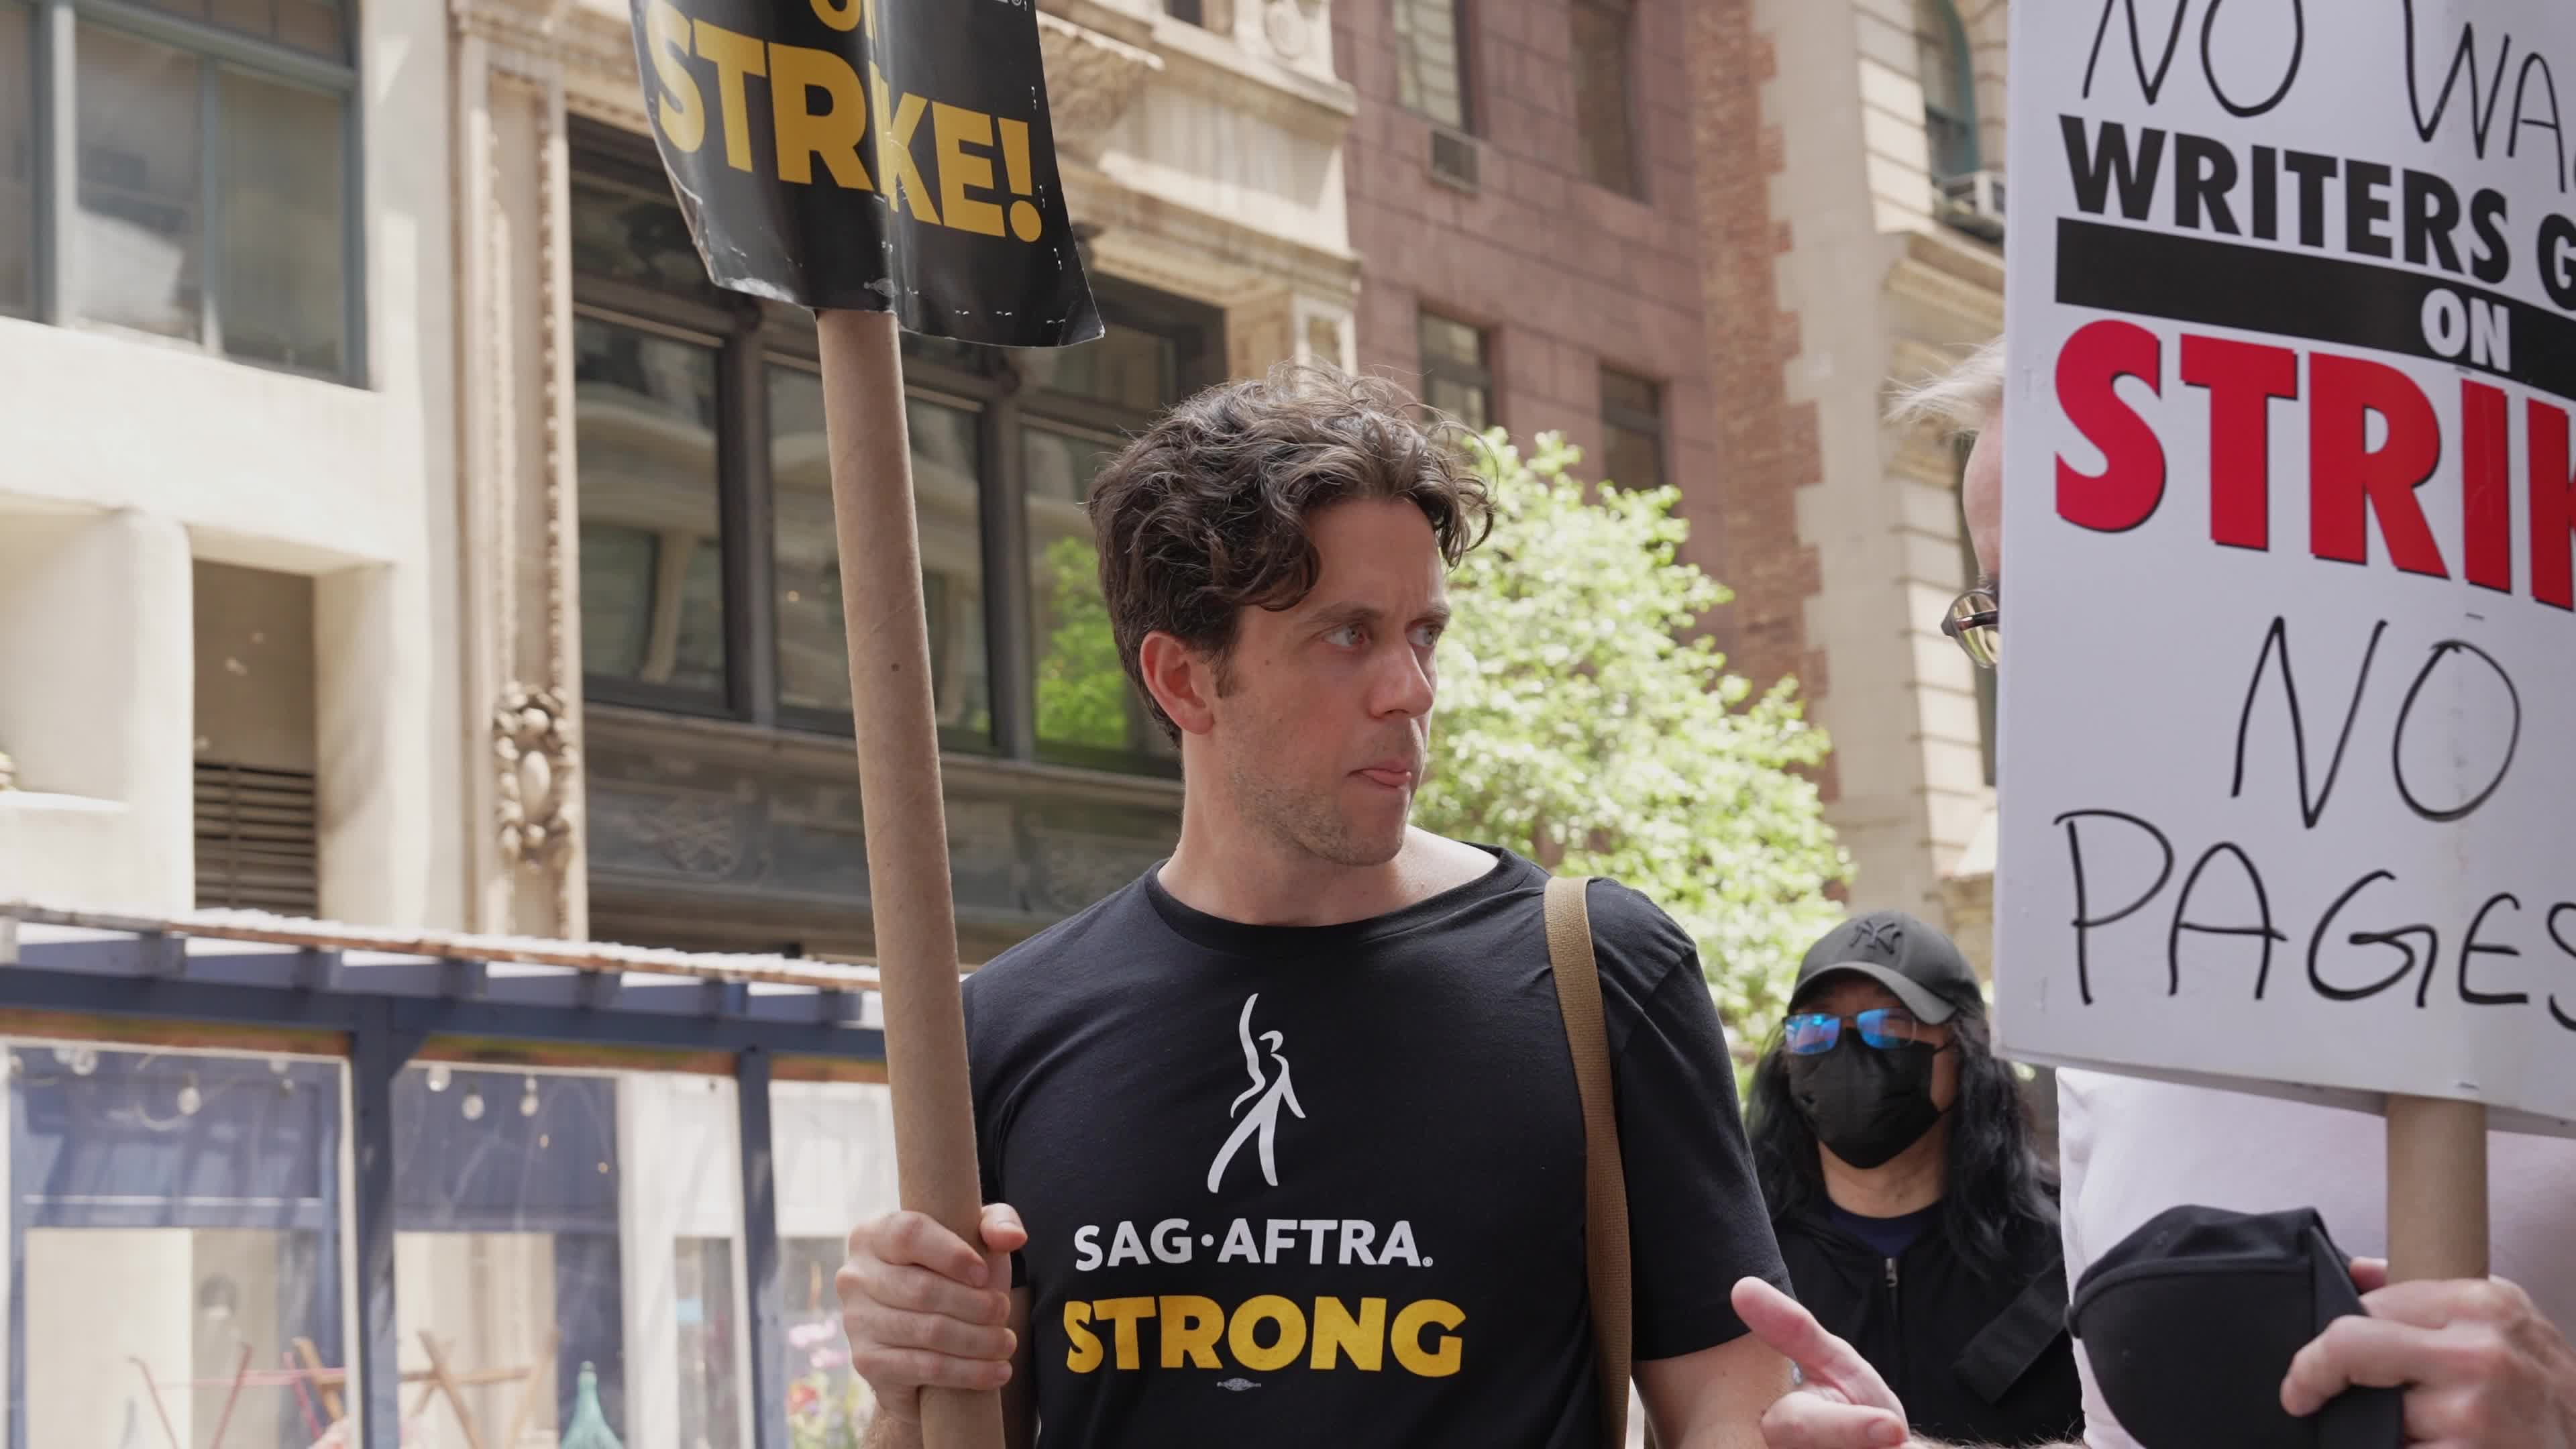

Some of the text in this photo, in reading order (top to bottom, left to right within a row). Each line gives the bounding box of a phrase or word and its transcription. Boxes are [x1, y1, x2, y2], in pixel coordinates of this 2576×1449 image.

[2083, 0, 2576, 193] NO WA
[2059, 114, 2510, 284] WRITERS
[2421, 288, 2510, 372] ON
[2231, 616, 2521, 829] NO
[1063, 1294, 1466, 1377] STRONG
